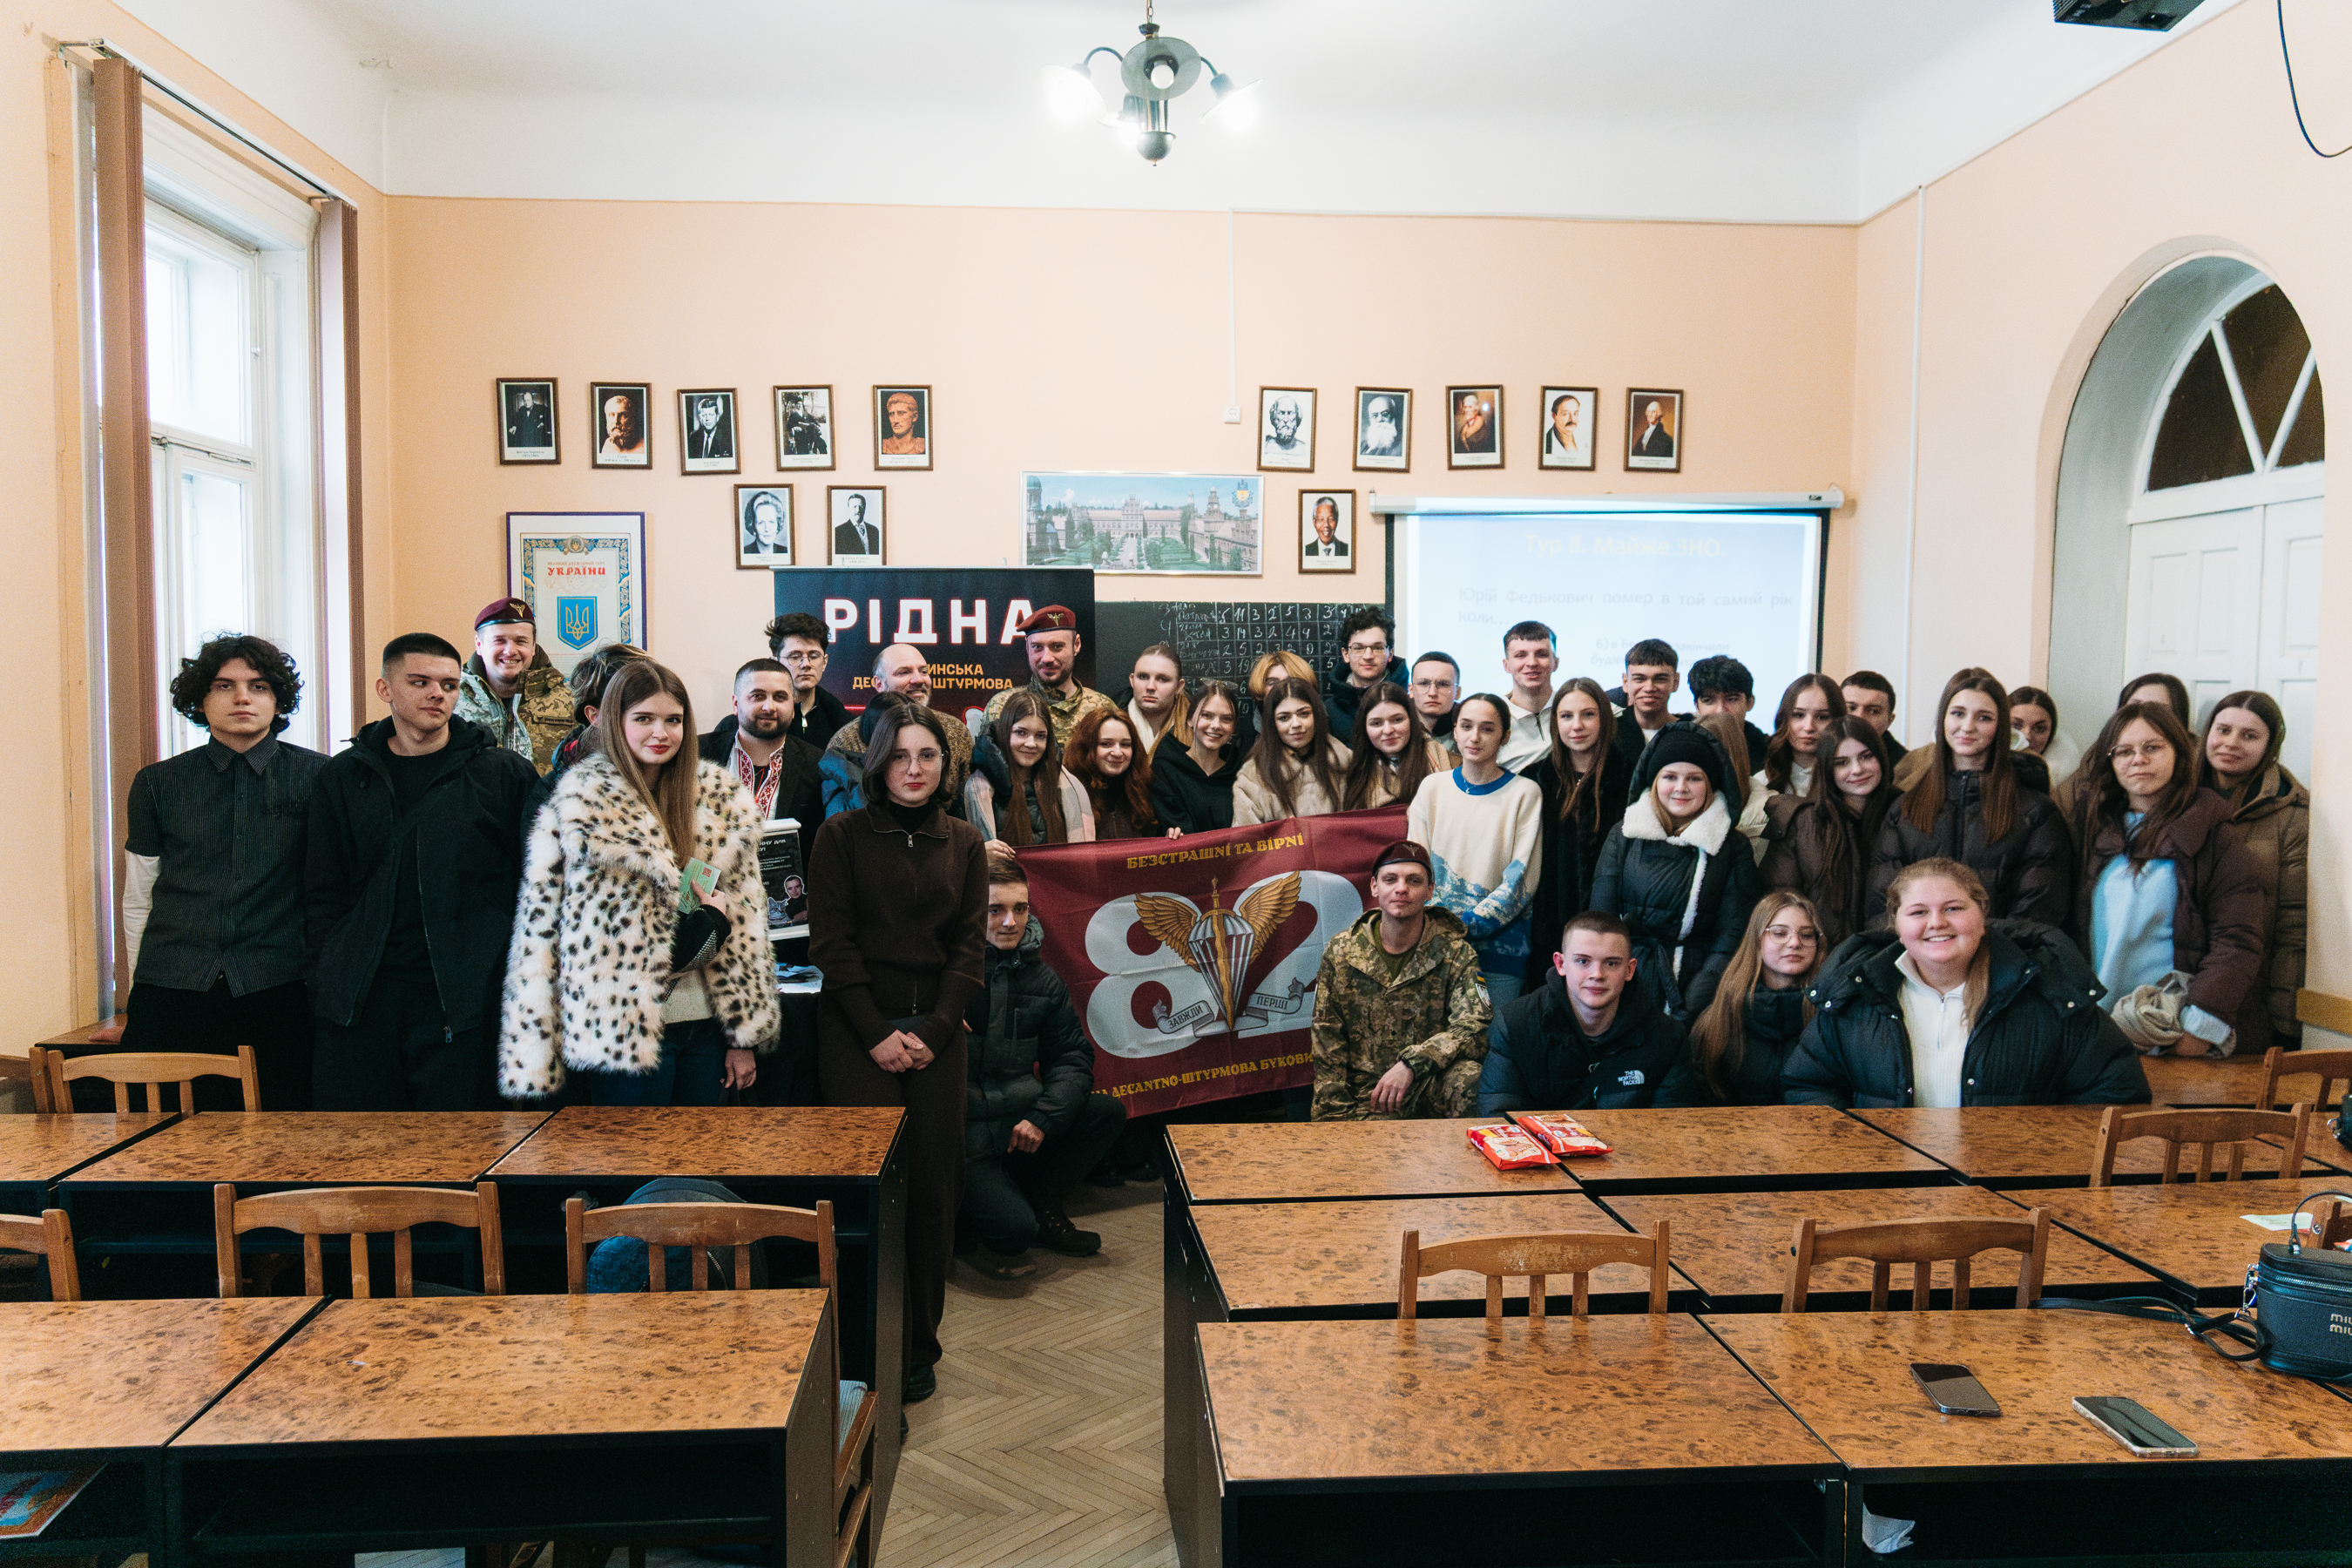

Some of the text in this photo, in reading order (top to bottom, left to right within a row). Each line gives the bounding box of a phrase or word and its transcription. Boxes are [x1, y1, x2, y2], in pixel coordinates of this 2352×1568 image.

[1524, 534, 1563, 559] Тур
[1568, 534, 1588, 554] 8.
[1593, 534, 1670, 556] Майже
[547, 565, 606, 576] УКРАЇНИ
[1458, 586, 1497, 605] Юрій
[1505, 590, 1594, 607] Федькович
[1602, 592, 1654, 608] помер
[1678, 591, 1707, 606] той
[1713, 590, 1763, 606] самий
[1769, 591, 1794, 609] рік
[1252, 608, 1260, 621] 3
[1268, 605, 1277, 620] 2
[1302, 607, 1312, 620] 3
[823, 598, 1034, 645] РІДНА
[1221, 626, 1230, 639] 3
[1254, 625, 1263, 639] 3
[1285, 625, 1295, 639] 4
[1323, 624, 1332, 636] 2
[1222, 644, 1232, 657] 2
[1240, 641, 1247, 656] 5
[927, 663, 984, 676] ИНСЬКА
[1224, 660, 1232, 674] 3
[1234, 842, 1254, 855] ТА
[1085, 869, 1363, 1059] 82
[1256, 996, 1288, 1010] ПЕРШІ
[1167, 1004, 1204, 1030] ЗАВЖДИ
